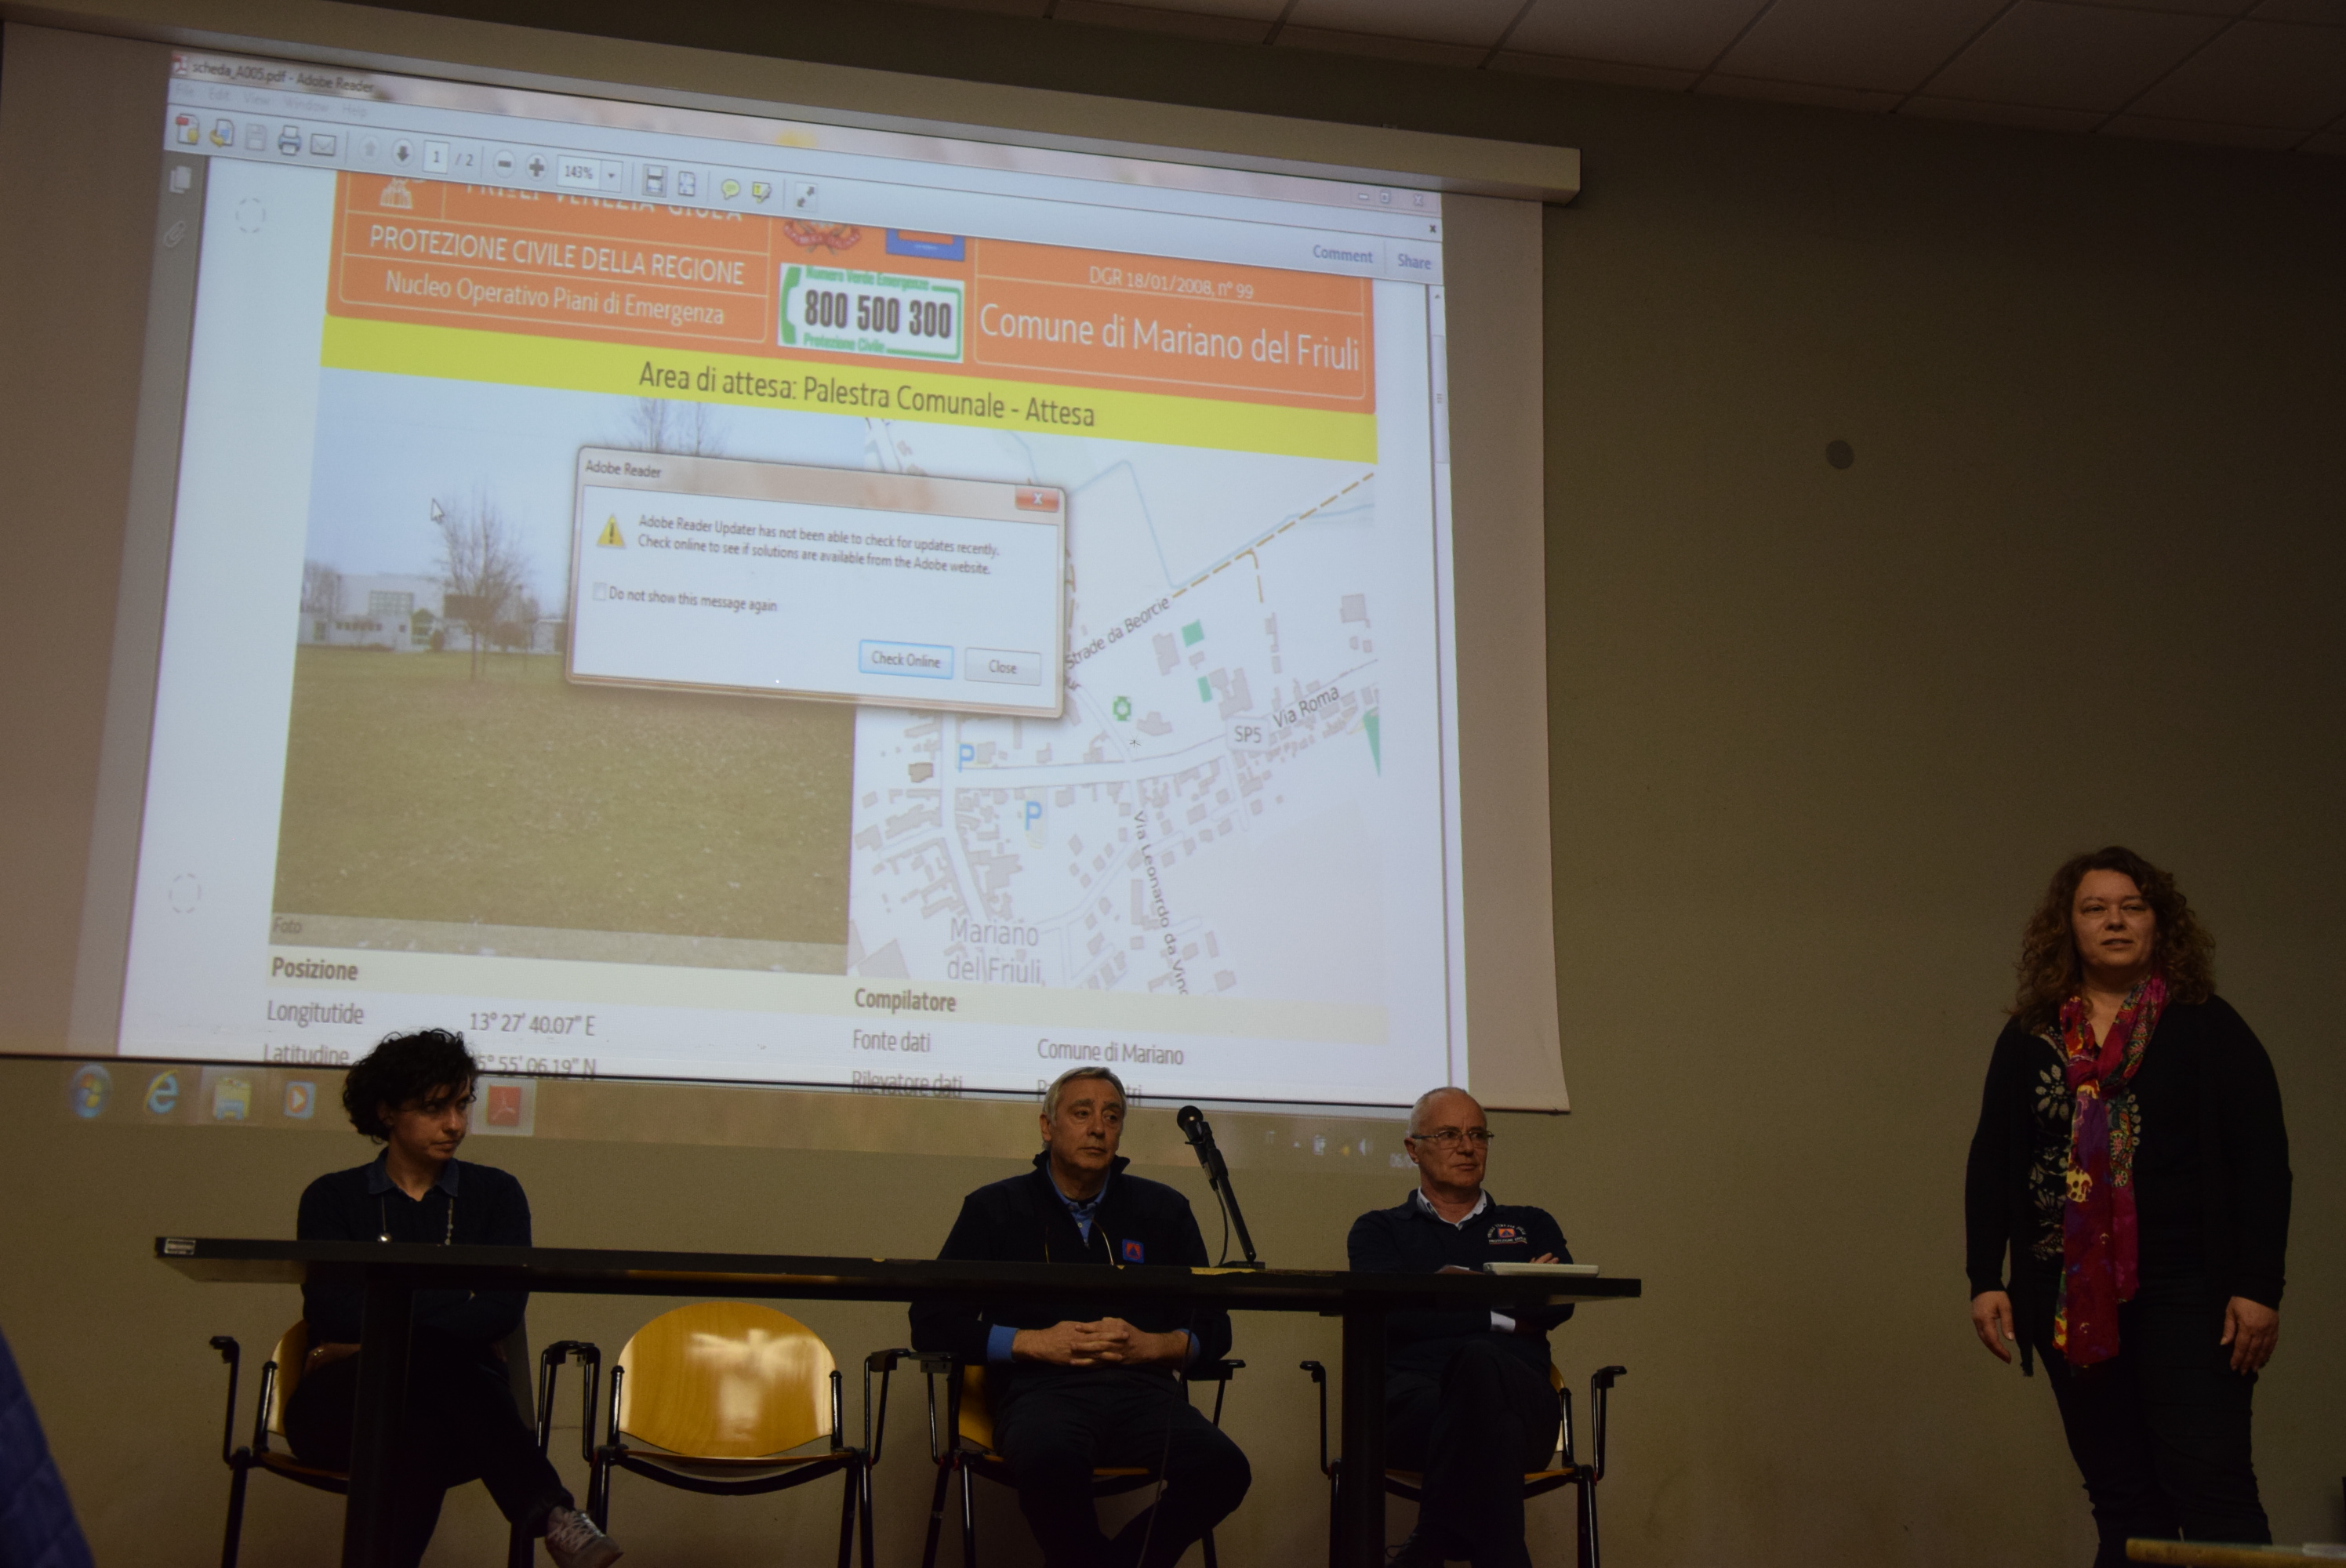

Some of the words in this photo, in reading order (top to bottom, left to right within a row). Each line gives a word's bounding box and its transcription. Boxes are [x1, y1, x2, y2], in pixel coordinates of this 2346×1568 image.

[296, 73, 332, 89] Adobe
[336, 77, 374, 92] Reader
[433, 151, 439, 163] 1
[465, 154, 473, 167] 2
[565, 165, 594, 180] 143%
[369, 223, 507, 261] PROTEZIONE
[511, 239, 577, 268] CIVILE
[580, 245, 646, 275] DELLA
[650, 252, 745, 285] REGIONE
[1313, 245, 1373, 263] Comment
[1397, 253, 1431, 270] Share
[1088, 266, 1123, 285] DGR
[1127, 272, 1215, 296] 18/01/2008,
[1236, 283, 1254, 299] 99
[385, 270, 452, 298] Nucleo
[456, 277, 549, 307] Operativo
[553, 286, 599, 312] Piani
[602, 291, 619, 314] di
[624, 293, 724, 327] Emergenza
[804, 289, 848, 328] 800
[857, 294, 900, 334] 500
[910, 299, 952, 339] 300
[979, 303, 1095, 346] Comune
[1102, 313, 1125, 348] di
[1132, 318, 1243, 359] Mariano
[1251, 328, 1289, 365] del
[1297, 334, 1360, 371] Friuli
[639, 361, 689, 390] Area
[697, 365, 716, 392] di
[722, 371, 797, 400] attesa:
[804, 376, 889, 408] Palestra
[897, 385, 1004, 419] Comunale
[1026, 397, 1095, 426] Attesa
[585, 459, 621, 475] Adobe
[624, 462, 662, 478] Reader
[639, 514, 674, 529] Adobe
[677, 516, 713, 532] Reader
[715, 520, 756, 539] Updater
[759, 524, 776, 538] has
[779, 528, 797, 540] not
[800, 528, 825, 542] been
[827, 529, 848, 544] able
[852, 533, 862, 545] to
[865, 535, 895, 547] check
[897, 535, 911, 549] for
[914, 539, 954, 554] updates
[957, 542, 1000, 559] recently.
[638, 534, 671, 549] Check
[674, 537, 706, 553] online
[709, 540, 720, 553] to
[723, 543, 740, 555] see
[743, 540, 749, 556] if
[752, 543, 798, 559] solutions
[801, 549, 818, 561] are
[820, 548, 865, 564] available
[867, 554, 892, 567] from
[895, 556, 911, 568] the
[913, 557, 947, 572] Adobe
[950, 560, 991, 575] website.
[609, 586, 625, 601] Do
[627, 589, 645, 602] not
[648, 590, 675, 604] show
[678, 593, 698, 606] this
[701, 597, 746, 612] message
[749, 598, 778, 615] again
[872, 650, 904, 666] Check
[906, 653, 941, 670] Online
[1066, 637, 1106, 670] Strade
[1107, 625, 1124, 644] da
[989, 659, 1018, 675] Close
[1273, 704, 1298, 728] Via
[1298, 686, 1340, 717] Roma
[1234, 724, 1262, 744] SP5
[1134, 810, 1146, 840] Via
[1141, 844, 1170, 928] Leonardo
[1164, 933, 1176, 955] da
[273, 916, 303, 935] Foto
[951, 917, 1040, 946] Mariano
[272, 957, 358, 981] Posizione
[947, 956, 980, 982] del
[988, 958, 1041, 984] Friuli
[267, 1000, 365, 1028] Longitutide
[855, 989, 957, 1014] Compilatore
[470, 1012, 496, 1031] 13°
[586, 1016, 595, 1036] E
[264, 1043, 350, 1064] Latitudine
[853, 1029, 897, 1051] Fonte
[901, 1031, 931, 1053] dati
[1037, 1039, 1101, 1062] Comune
[1104, 1041, 1118, 1062] di
[1122, 1044, 1184, 1065] Mariano
[583, 1058, 597, 1076] N
